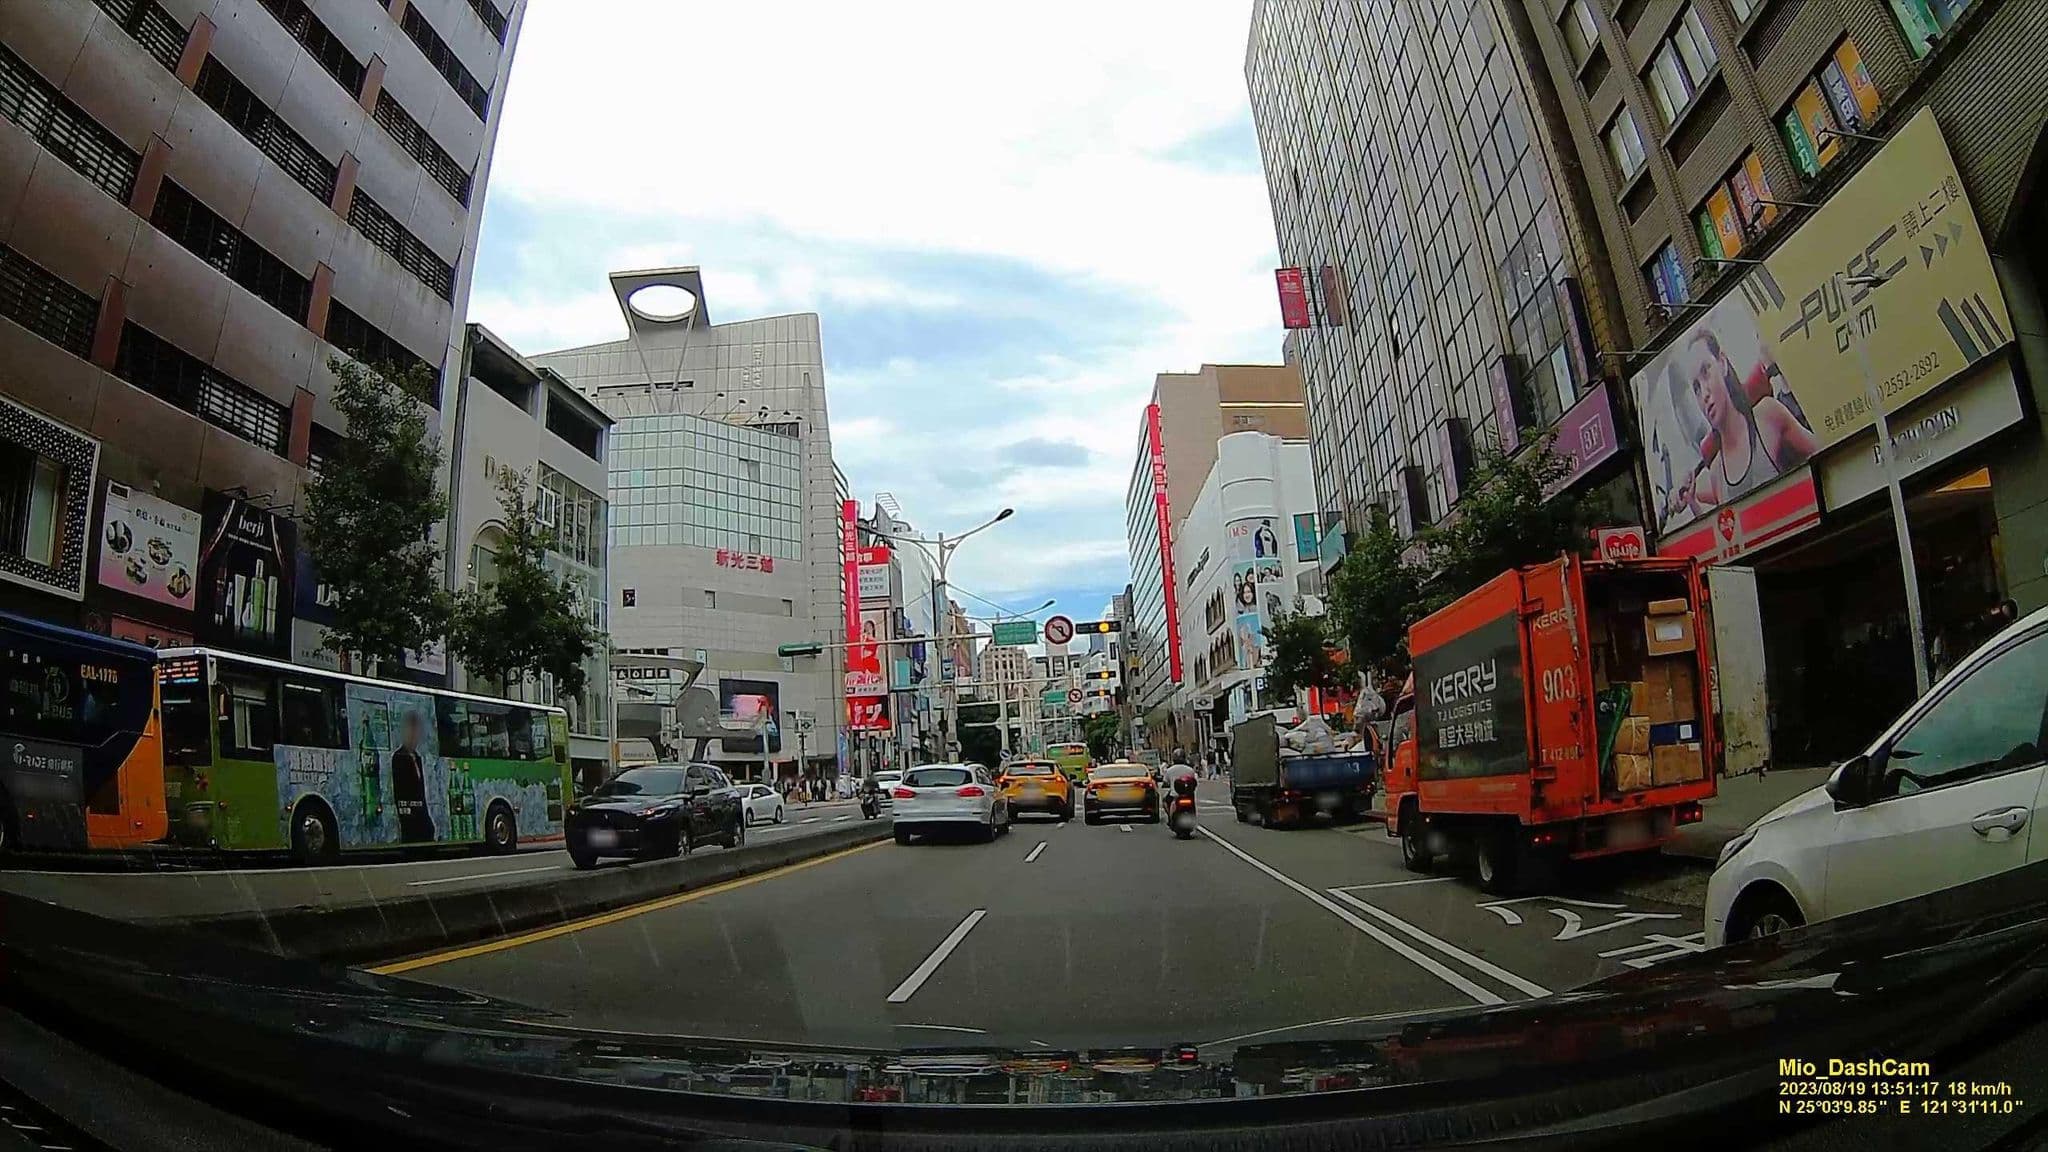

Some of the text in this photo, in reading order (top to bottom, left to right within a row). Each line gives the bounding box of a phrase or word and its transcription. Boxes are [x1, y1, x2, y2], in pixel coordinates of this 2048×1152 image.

[1902, 175, 1960, 240] 請上二樓
[1429, 657, 1497, 708] KERRY
[1543, 664, 1577, 704] 903
[1448, 698, 1493, 721] LOGISTICS
